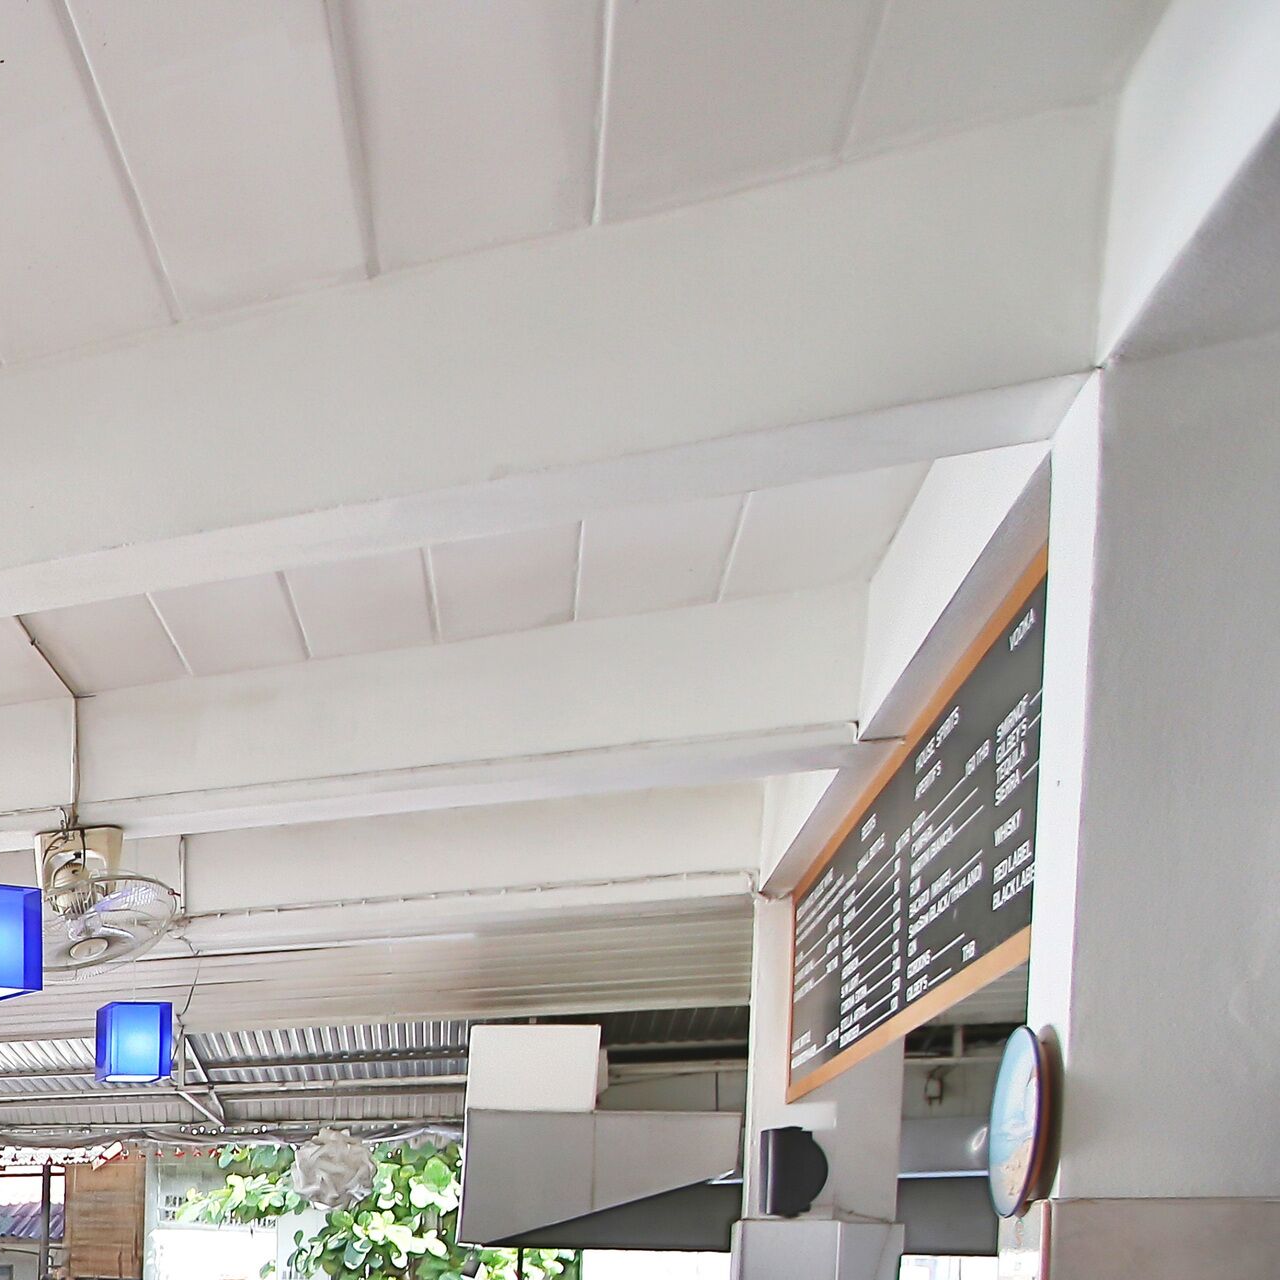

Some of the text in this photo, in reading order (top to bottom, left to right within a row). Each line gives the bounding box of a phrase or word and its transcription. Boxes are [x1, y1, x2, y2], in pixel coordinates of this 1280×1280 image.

[1008, 608, 1036, 651] VODKA
[993, 808, 1022, 847] WHISKY
[993, 840, 1032, 885] RED LABEL
[992, 861, 1036, 911] BLACK LABE
